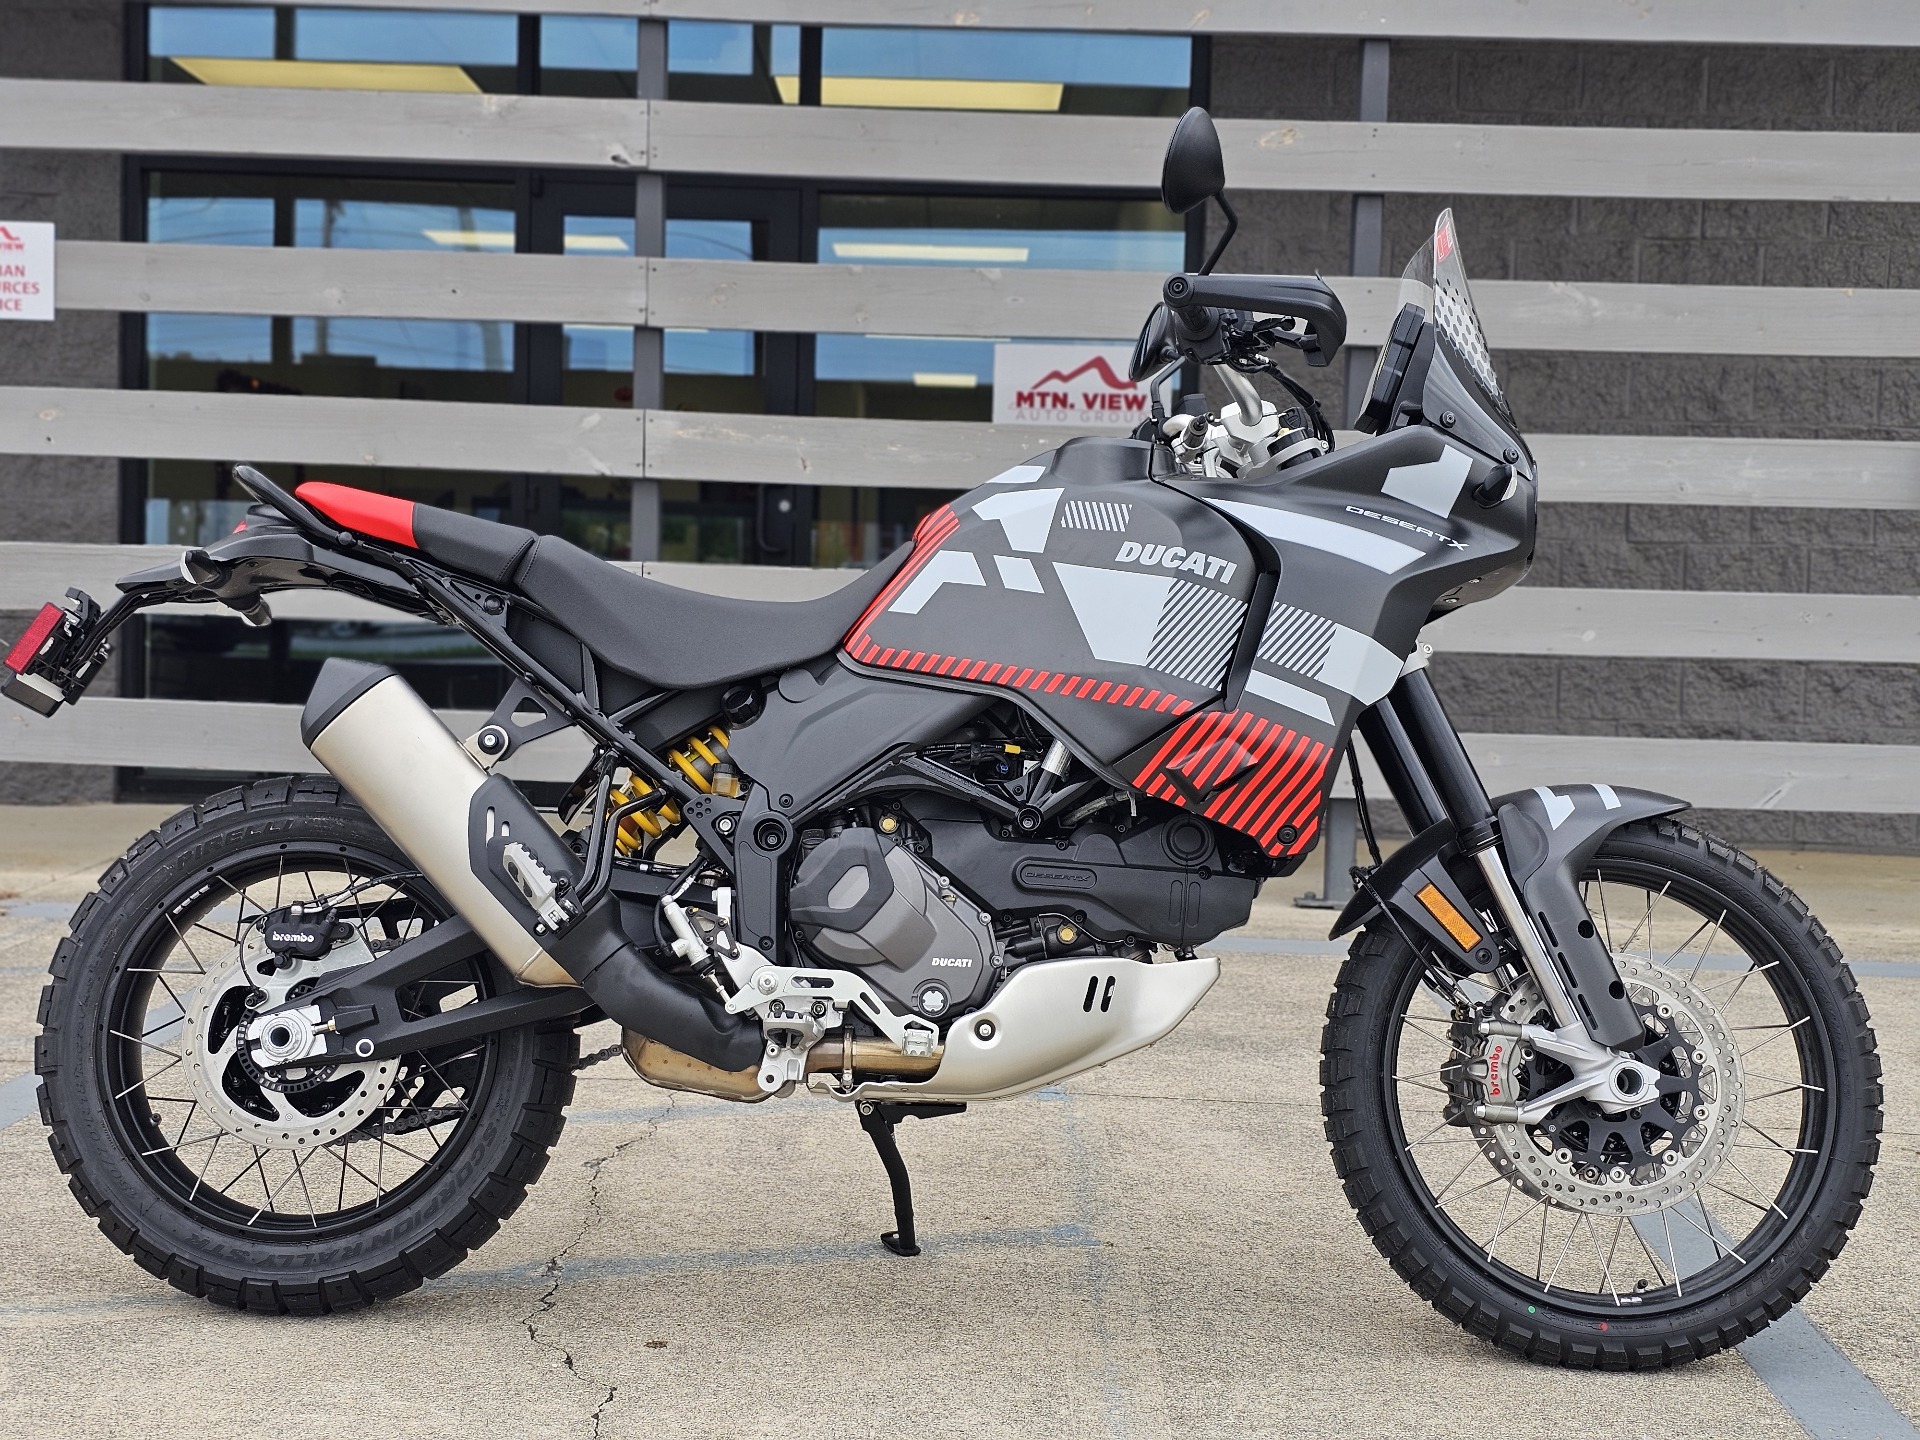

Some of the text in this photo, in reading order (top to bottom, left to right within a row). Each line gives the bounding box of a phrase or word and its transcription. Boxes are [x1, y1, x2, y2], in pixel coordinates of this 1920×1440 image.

[1015, 391, 1148, 411] MTN. VIEW
[1015, 409, 1068, 422] AUTO
[1346, 505, 1469, 551] DESERTX
[1114, 541, 1238, 585] DUCATI
[272, 931, 314, 943] brembo
[931, 957, 973, 968] DUCATI
[1489, 1045, 1503, 1096] brembo
